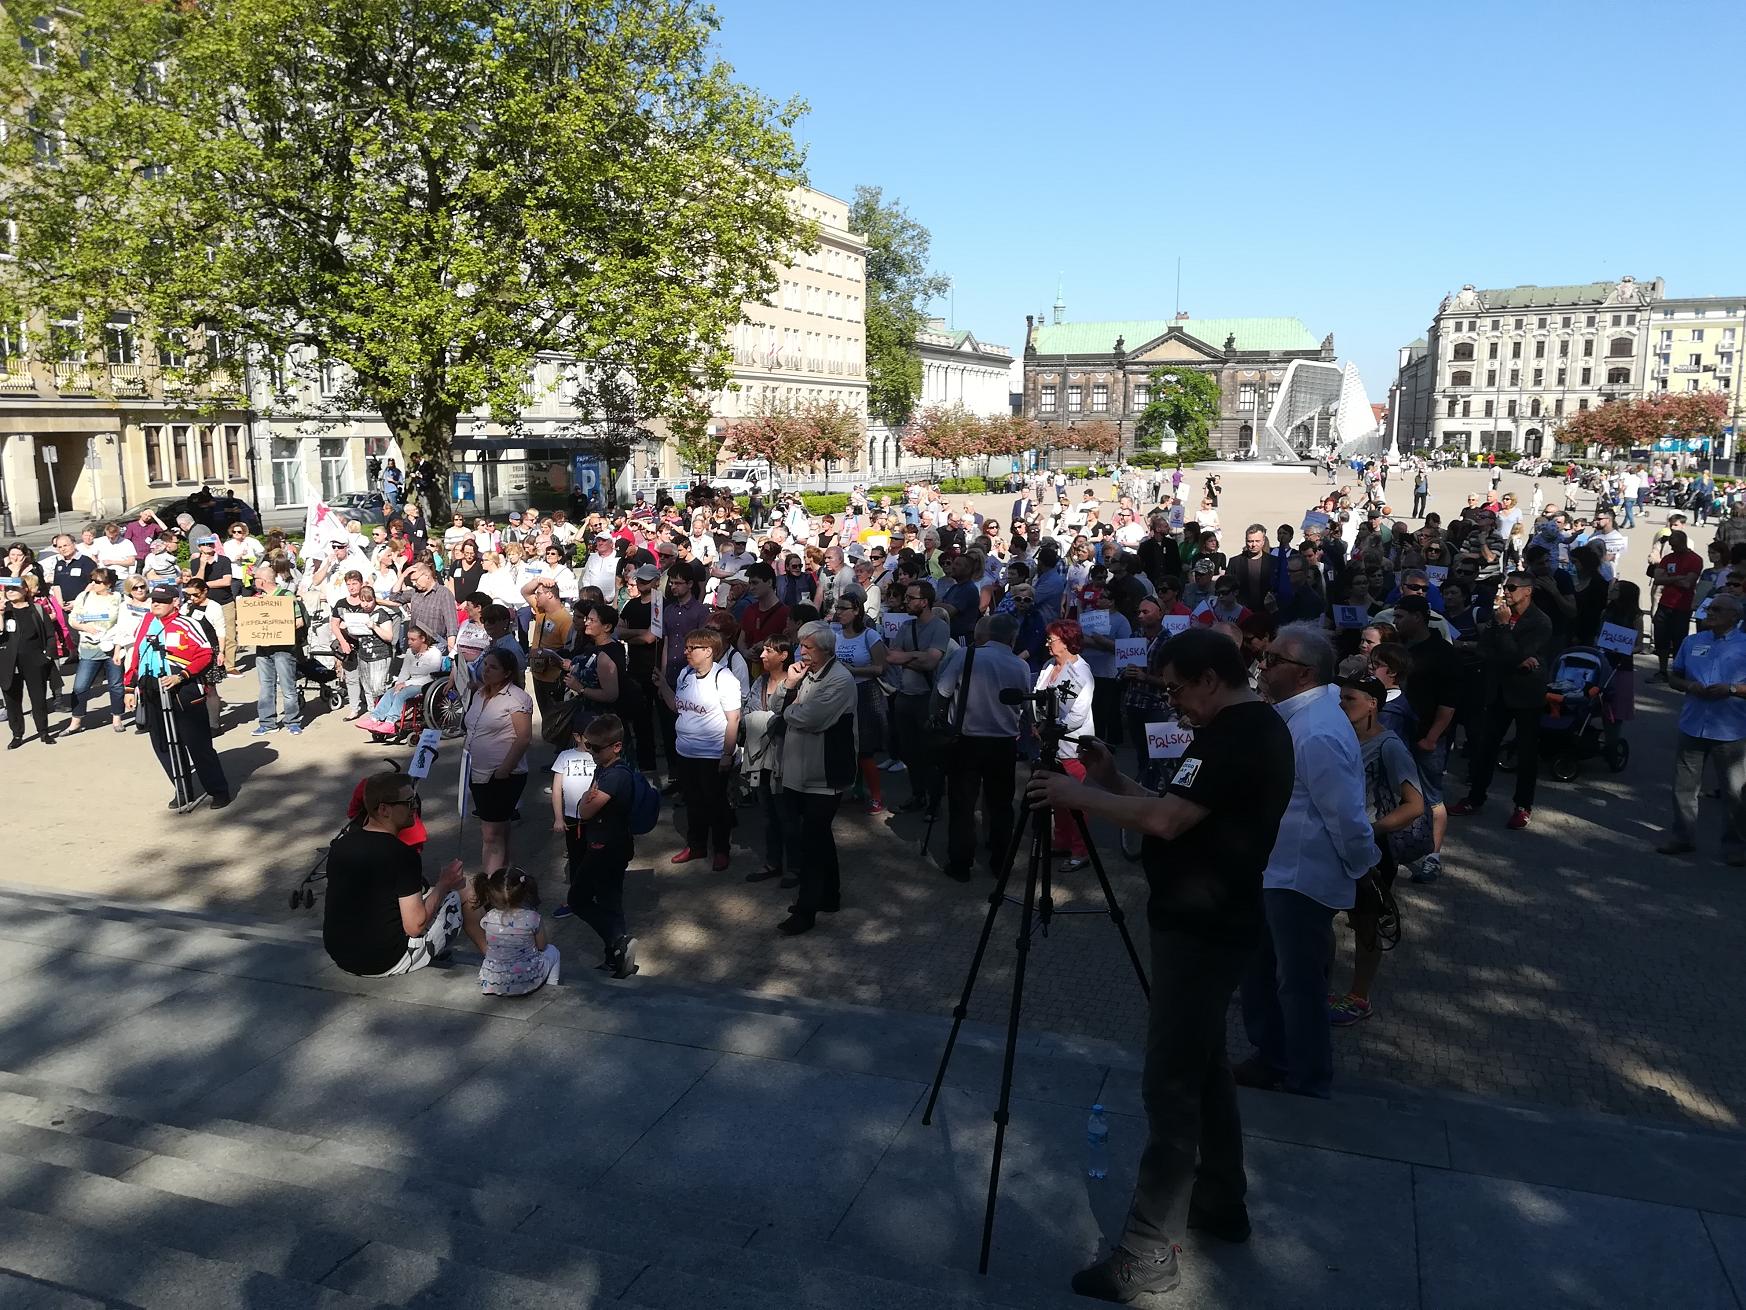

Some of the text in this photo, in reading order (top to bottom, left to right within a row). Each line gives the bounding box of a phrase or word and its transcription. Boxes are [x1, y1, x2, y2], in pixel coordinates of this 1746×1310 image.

[458, 480, 471, 499] P
[582, 469, 596, 497] P
[242, 600, 283, 608] SOLIDARNI
[1600, 630, 1633, 646] POLSKA
[1116, 647, 1146, 660] POLSKA
[674, 696, 708, 716] POLSKA
[1148, 733, 1192, 749] POLSKA
